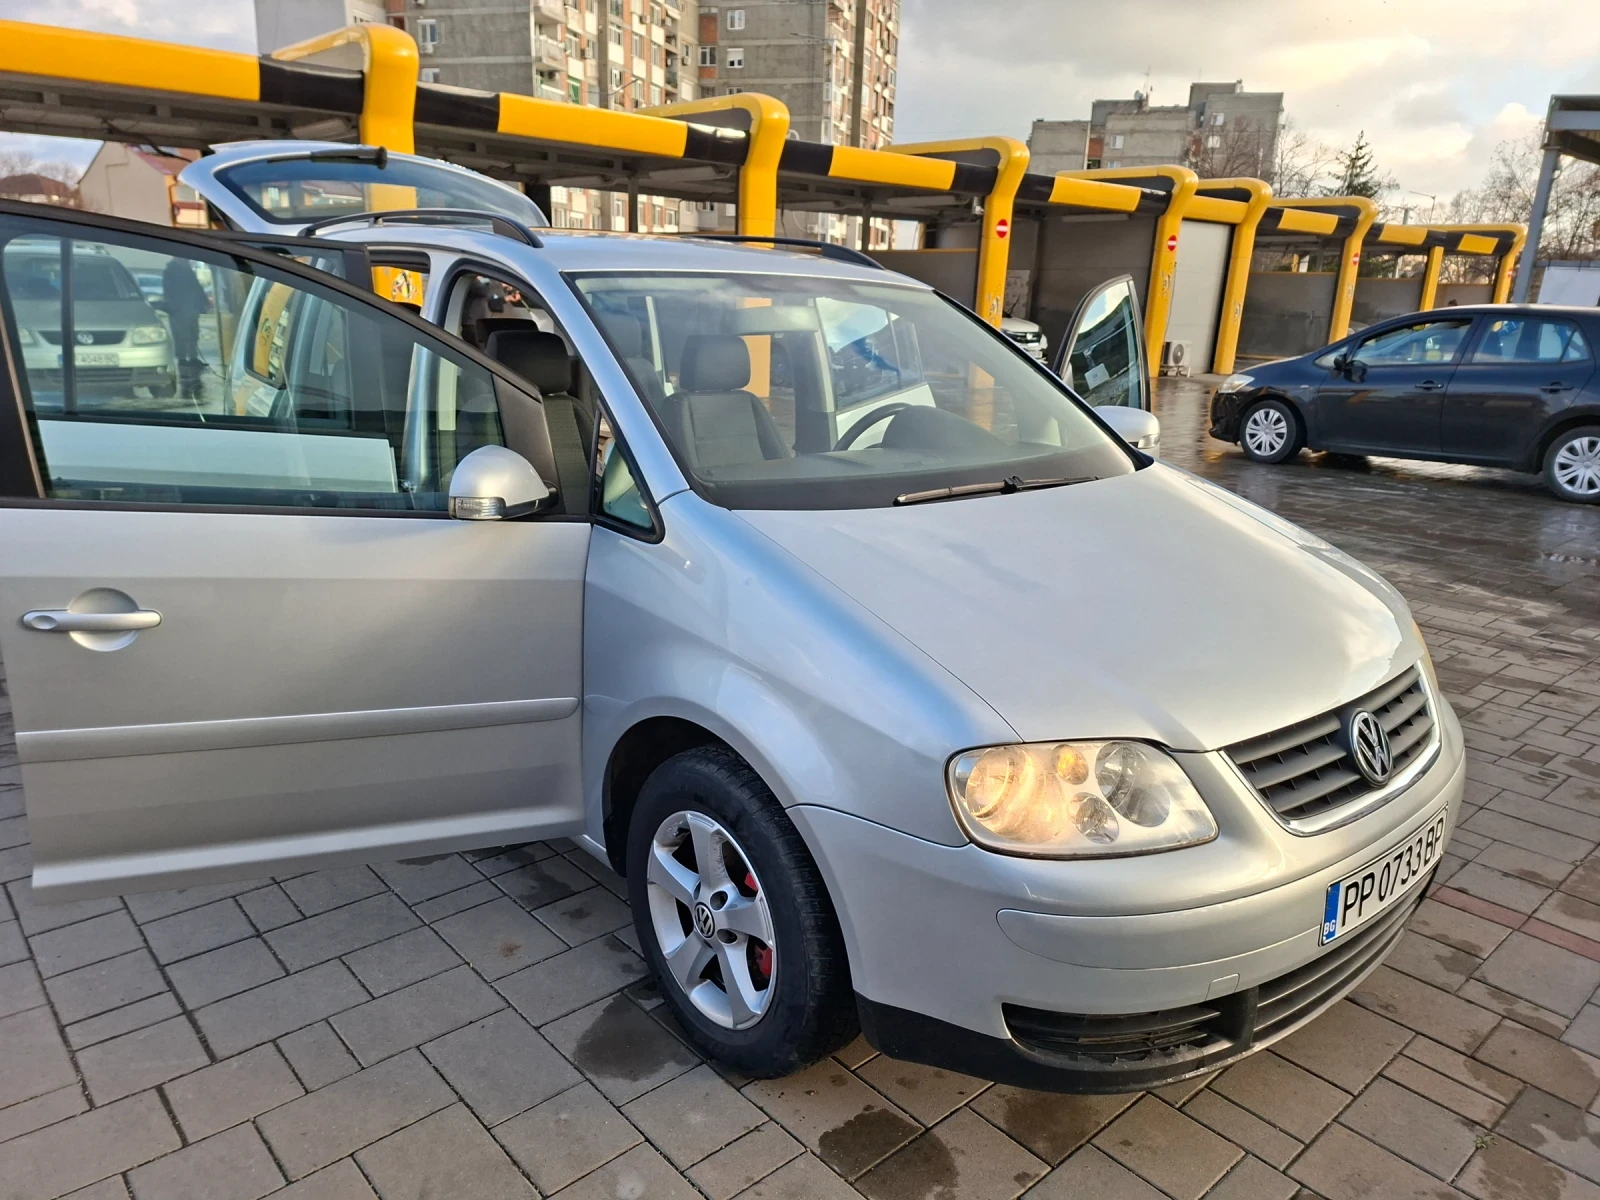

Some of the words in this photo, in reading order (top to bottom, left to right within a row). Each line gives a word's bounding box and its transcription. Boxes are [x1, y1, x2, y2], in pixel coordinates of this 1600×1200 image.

[1342, 872, 1375, 927] PP
[1378, 836, 1423, 902] 0733
[1424, 817, 1444, 867] BP
[1324, 919, 1336, 935] BG
